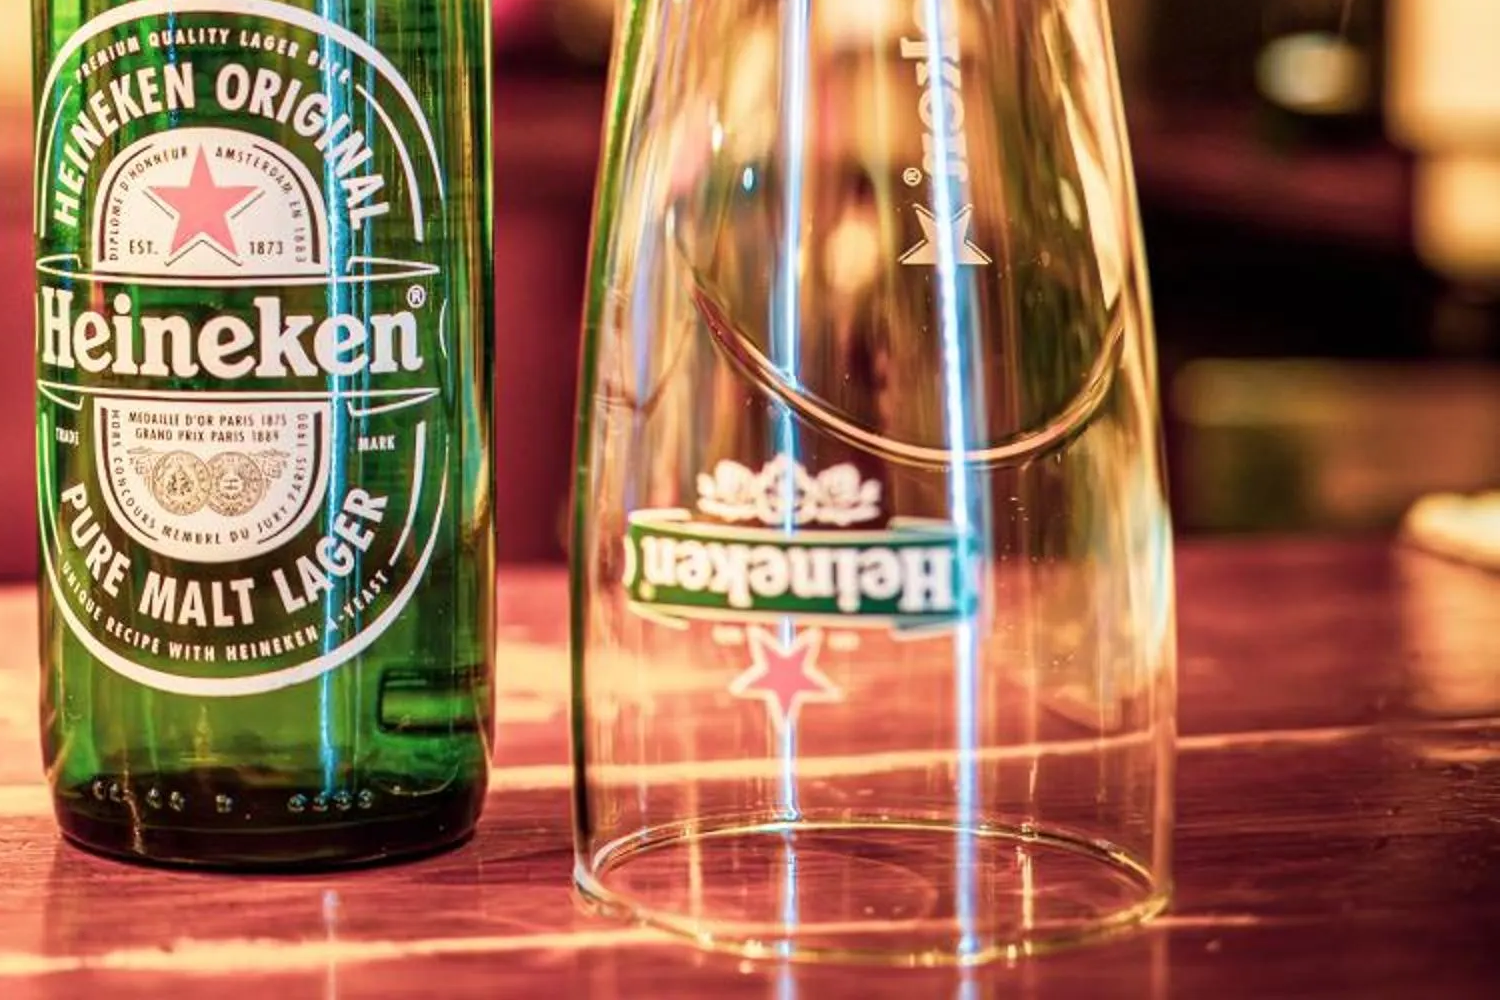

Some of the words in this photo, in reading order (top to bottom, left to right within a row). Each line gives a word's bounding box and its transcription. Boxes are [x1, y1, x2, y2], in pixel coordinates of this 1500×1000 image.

[148, 28, 230, 47] QUALITY
[240, 30, 299, 59] LAGER
[53, 62, 196, 227] HEINEKEN
[215, 63, 390, 230] ORIGINAL
[215, 146, 293, 194] AMSTERDAM
[129, 240, 159, 255] EST.
[249, 241, 283, 255] 1873
[41, 286, 424, 379] Heineken
[135, 427, 173, 441] GRAND
[179, 430, 204, 441] PRIX
[211, 430, 245, 442] PARIS
[185, 414, 213, 426] D'OR
[220, 414, 254, 427] PARIS
[357, 434, 396, 452] MARK
[114, 457, 156, 528] CONCOURS
[229, 527, 249, 543] DU
[61, 482, 131, 598] PURE
[138, 570, 255, 628] MALT
[271, 487, 389, 614] LAGER
[641, 535, 956, 612] Heineken
[62, 561, 102, 621] UNIQUE
[105, 616, 160, 655] RECIPE
[168, 641, 216, 662] WITH
[225, 624, 319, 661] HEINEKEN
